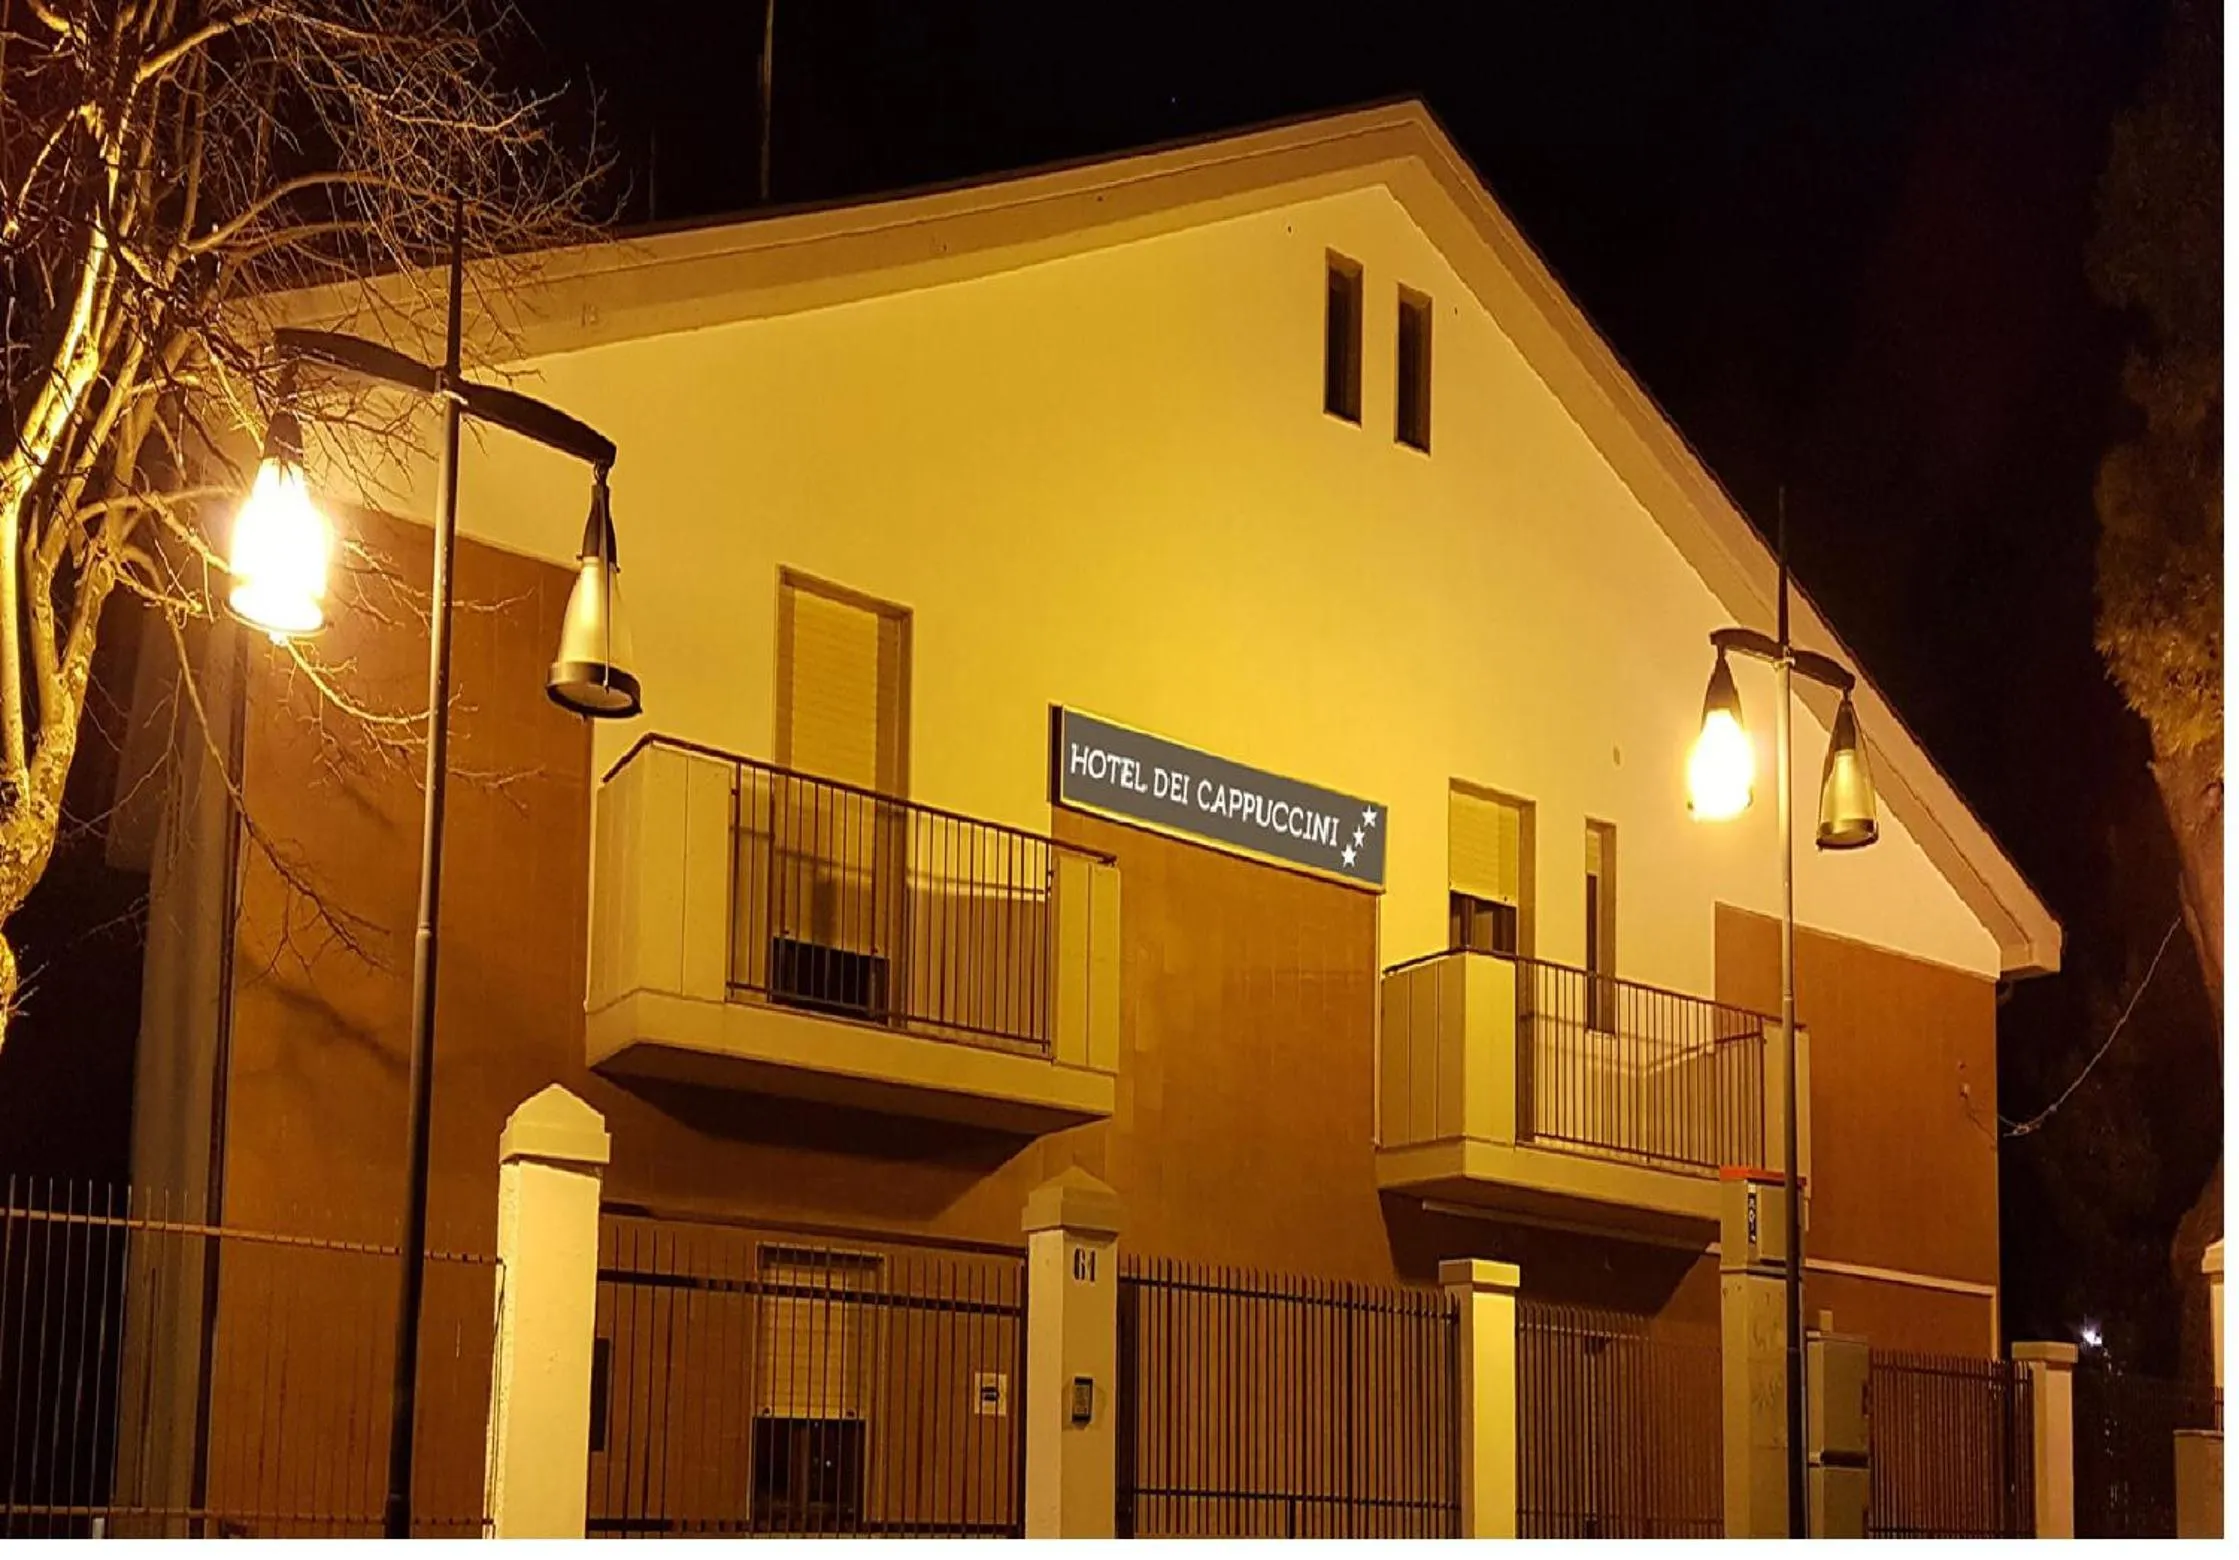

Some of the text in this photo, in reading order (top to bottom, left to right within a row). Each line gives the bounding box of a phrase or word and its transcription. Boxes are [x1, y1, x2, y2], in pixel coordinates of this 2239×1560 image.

[1070, 743, 1340, 847] HOTEL DEI CAPPUCCINI
